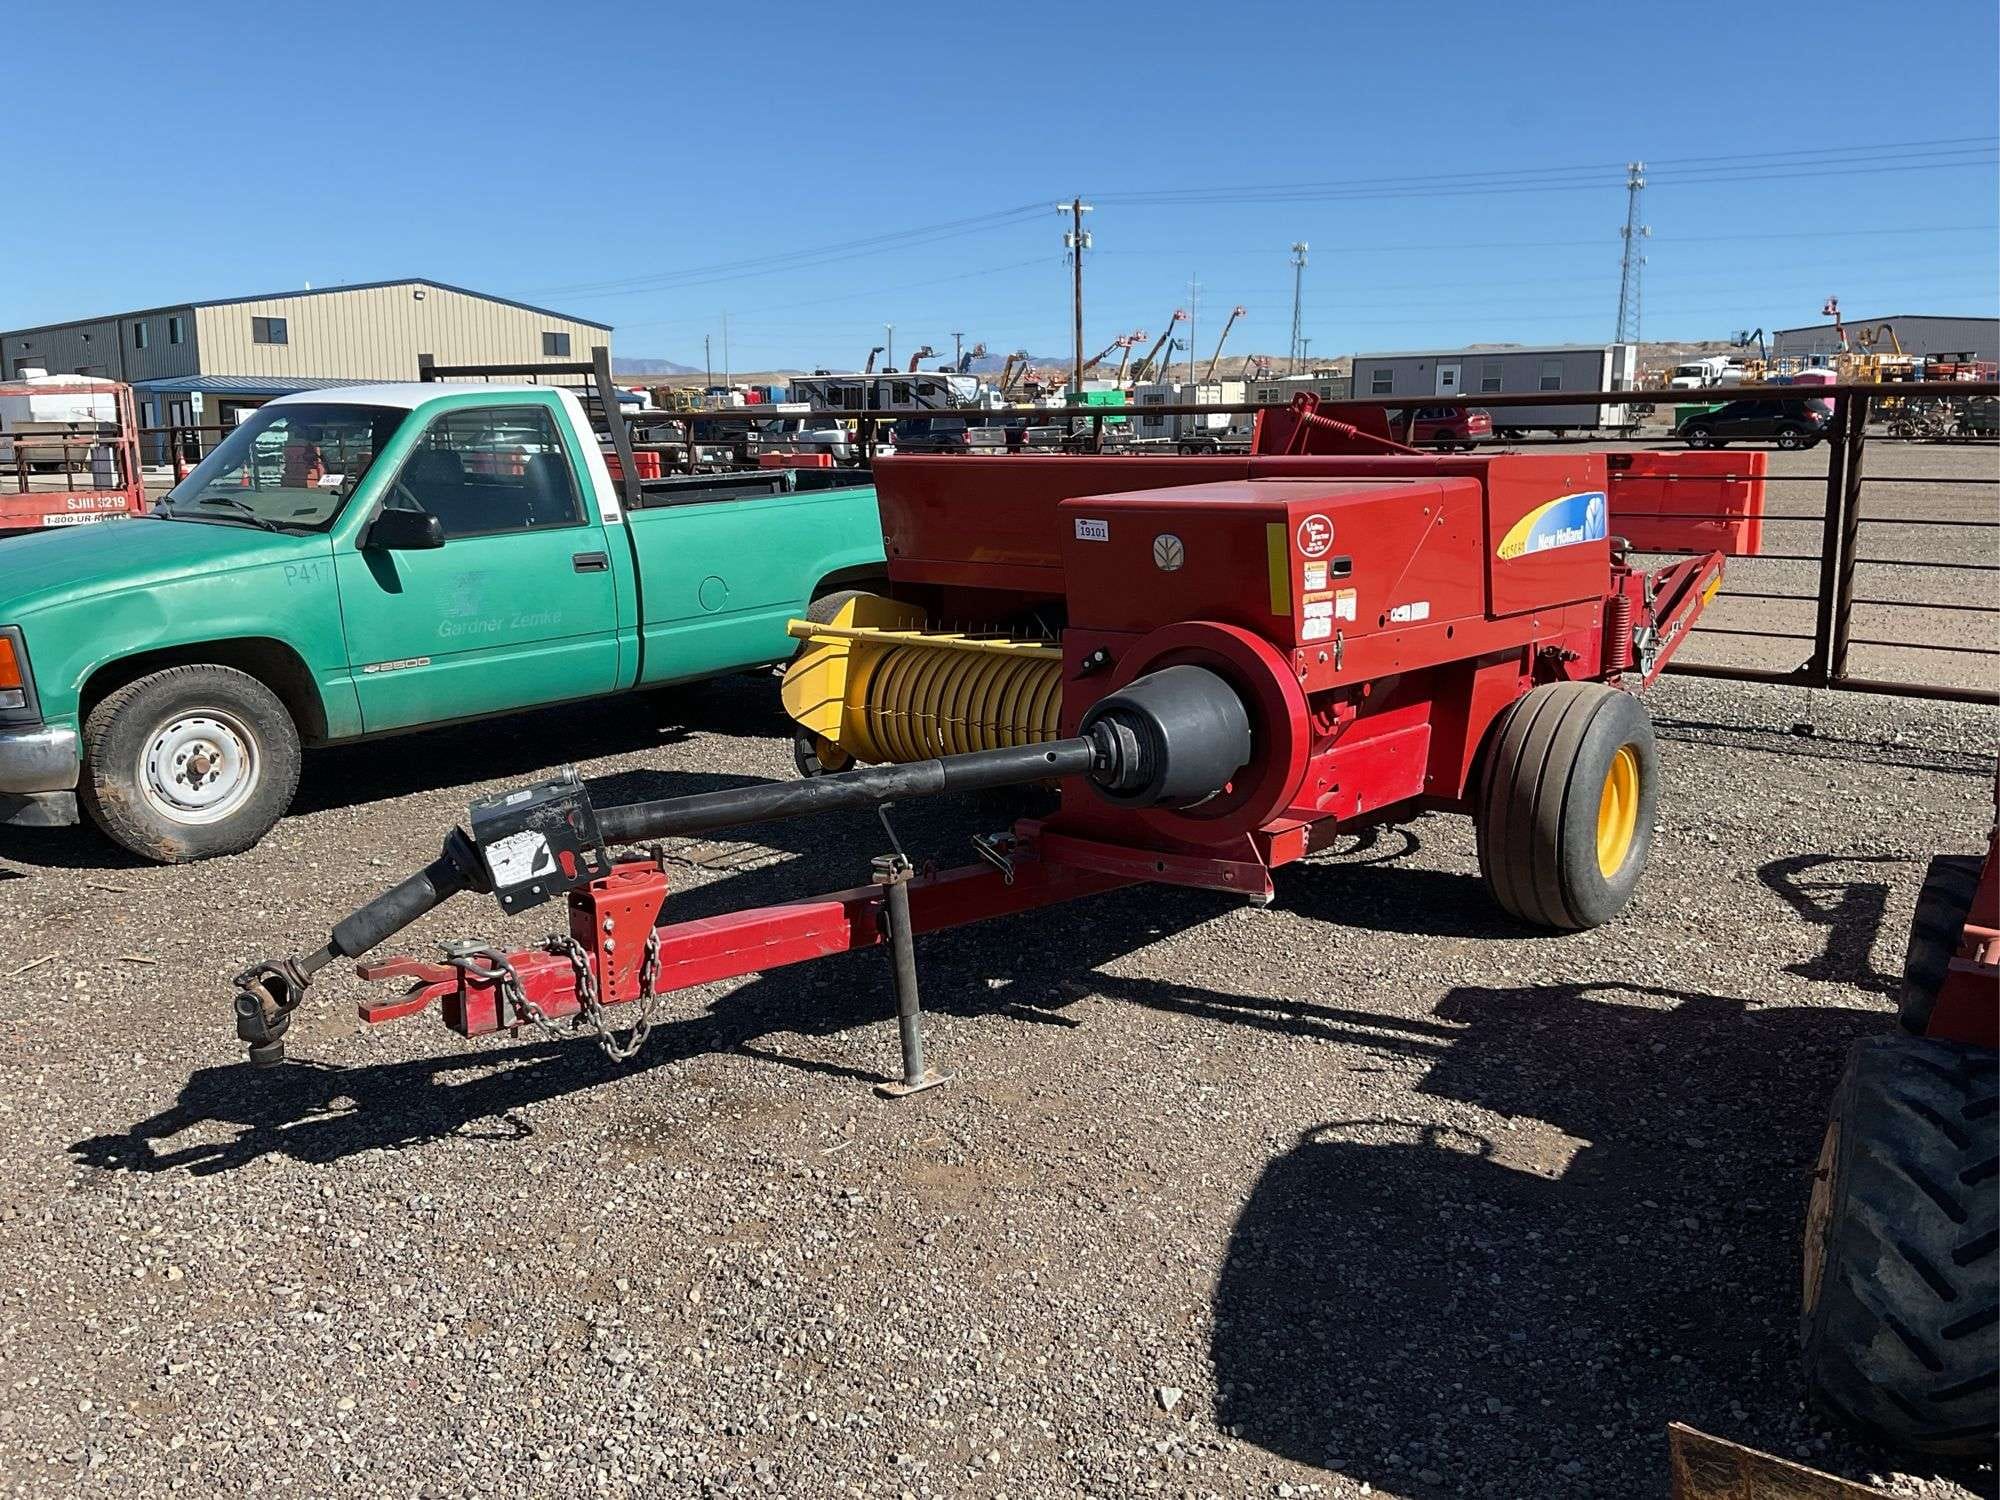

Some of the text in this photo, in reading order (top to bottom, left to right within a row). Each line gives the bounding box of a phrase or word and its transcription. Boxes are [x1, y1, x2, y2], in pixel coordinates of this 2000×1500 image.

[97, 497, 126, 508] 3219
[1080, 527, 1106, 537] 19101
[1538, 525, 1584, 549] New Holland
[439, 610, 561, 637] Gardner Zemke
